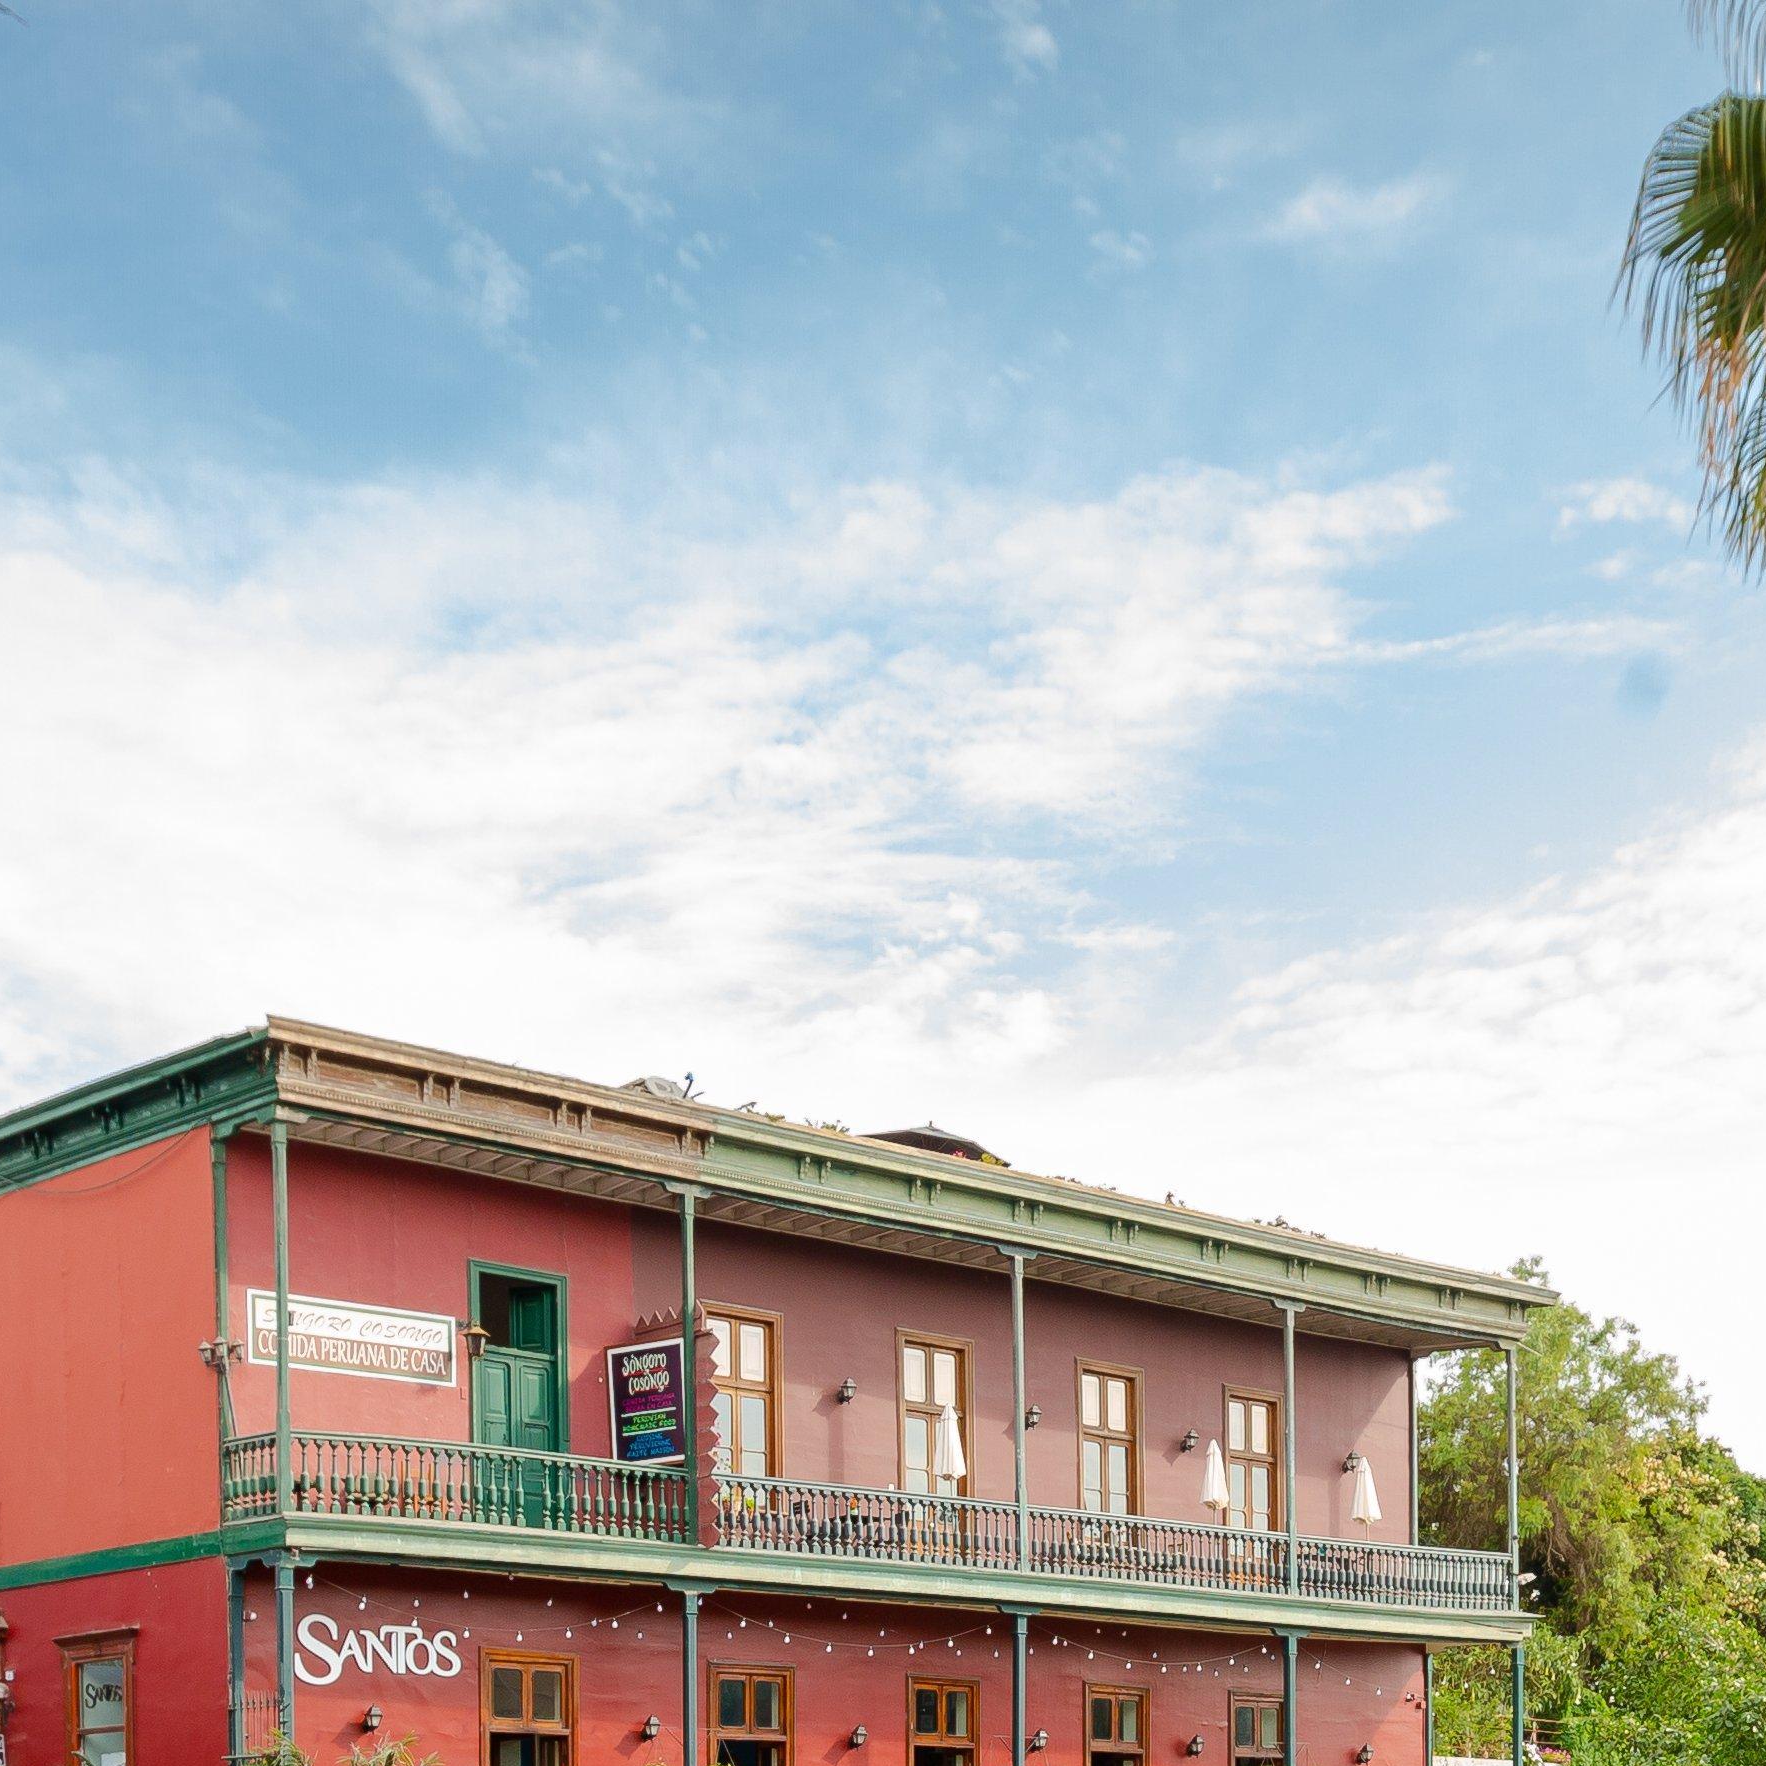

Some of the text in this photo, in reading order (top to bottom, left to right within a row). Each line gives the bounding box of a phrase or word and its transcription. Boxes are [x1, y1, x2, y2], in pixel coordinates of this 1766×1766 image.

[258, 1330, 447, 1376] COIDA PERUANA DE CASA
[294, 1613, 463, 1686] SANTOS
